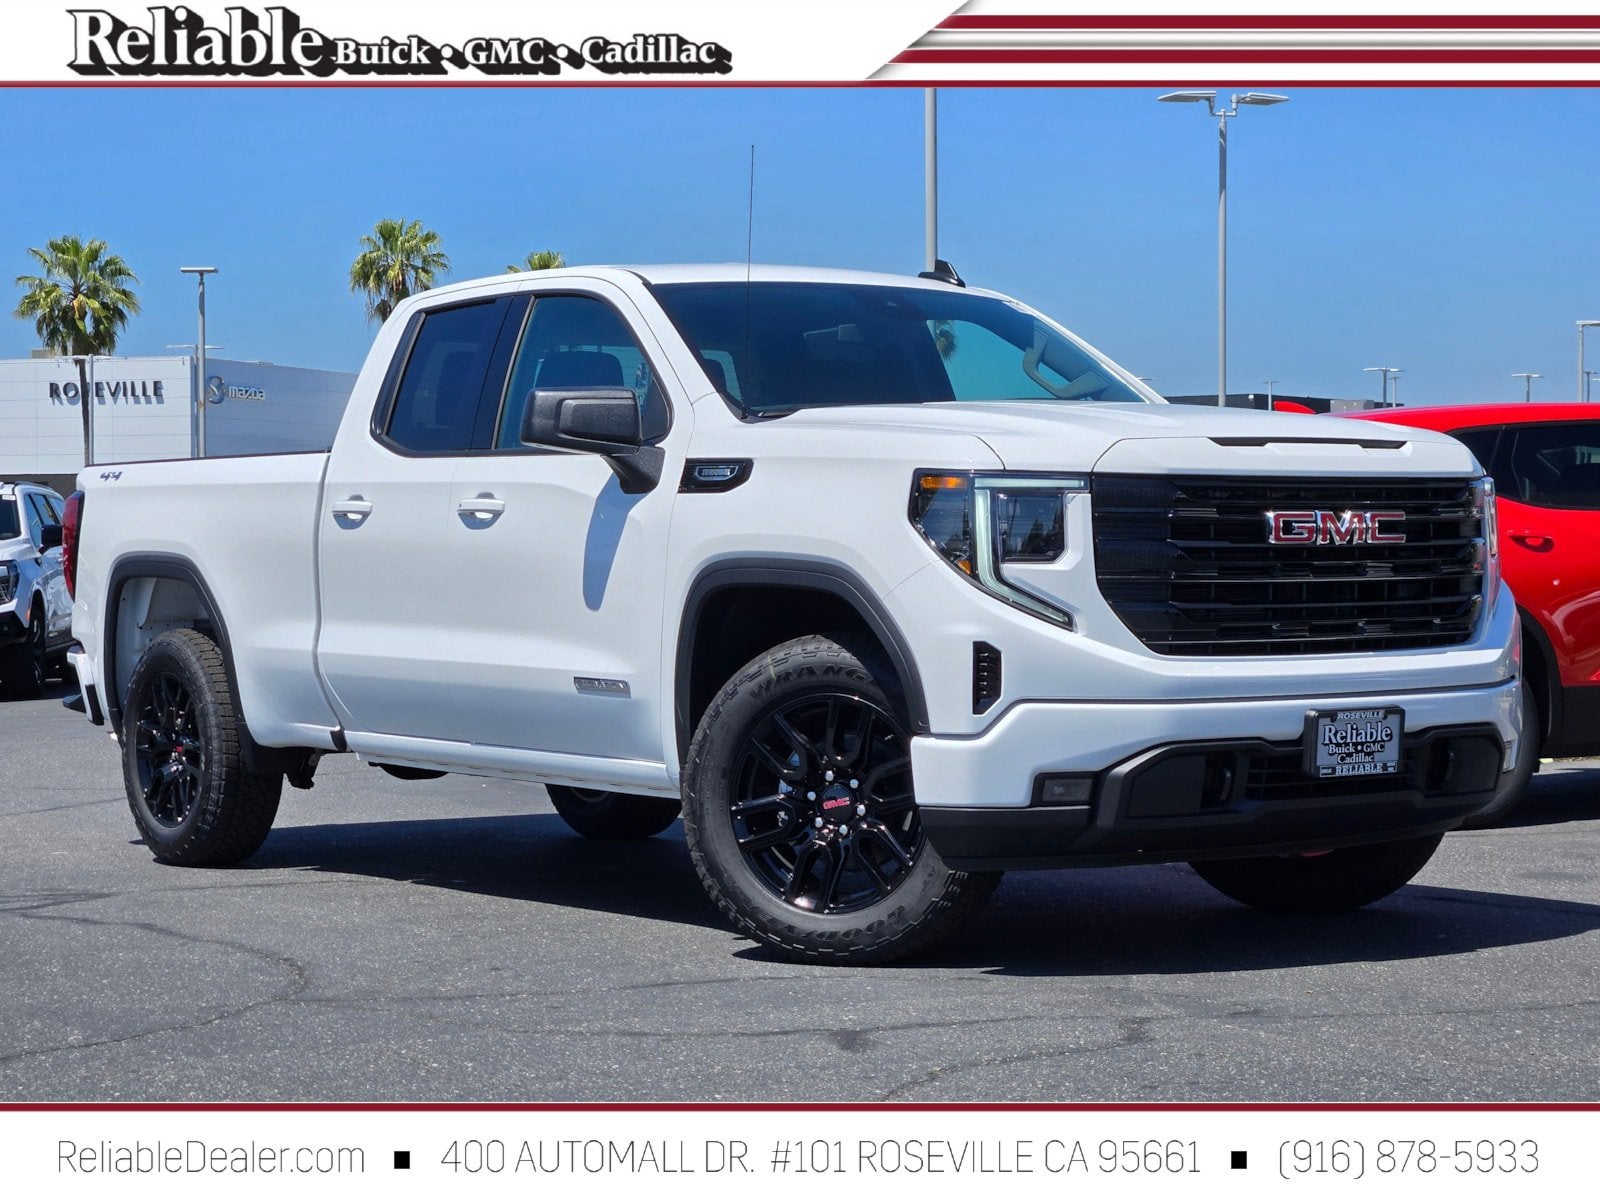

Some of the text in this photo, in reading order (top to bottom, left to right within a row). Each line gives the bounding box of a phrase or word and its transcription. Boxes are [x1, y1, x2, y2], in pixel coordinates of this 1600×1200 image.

[49, 380, 163, 400] ROEVILLE
[1266, 509, 1406, 545] GMC
[749, 663, 870, 699] WRANG
[1337, 711, 1385, 720] ROSEVILLE
[1322, 722, 1393, 745] Reliable
[1328, 742, 1385, 755] Buick GMC
[1337, 753, 1375, 764] Cadillac
[1335, 763, 1383, 775] RELIABLE
